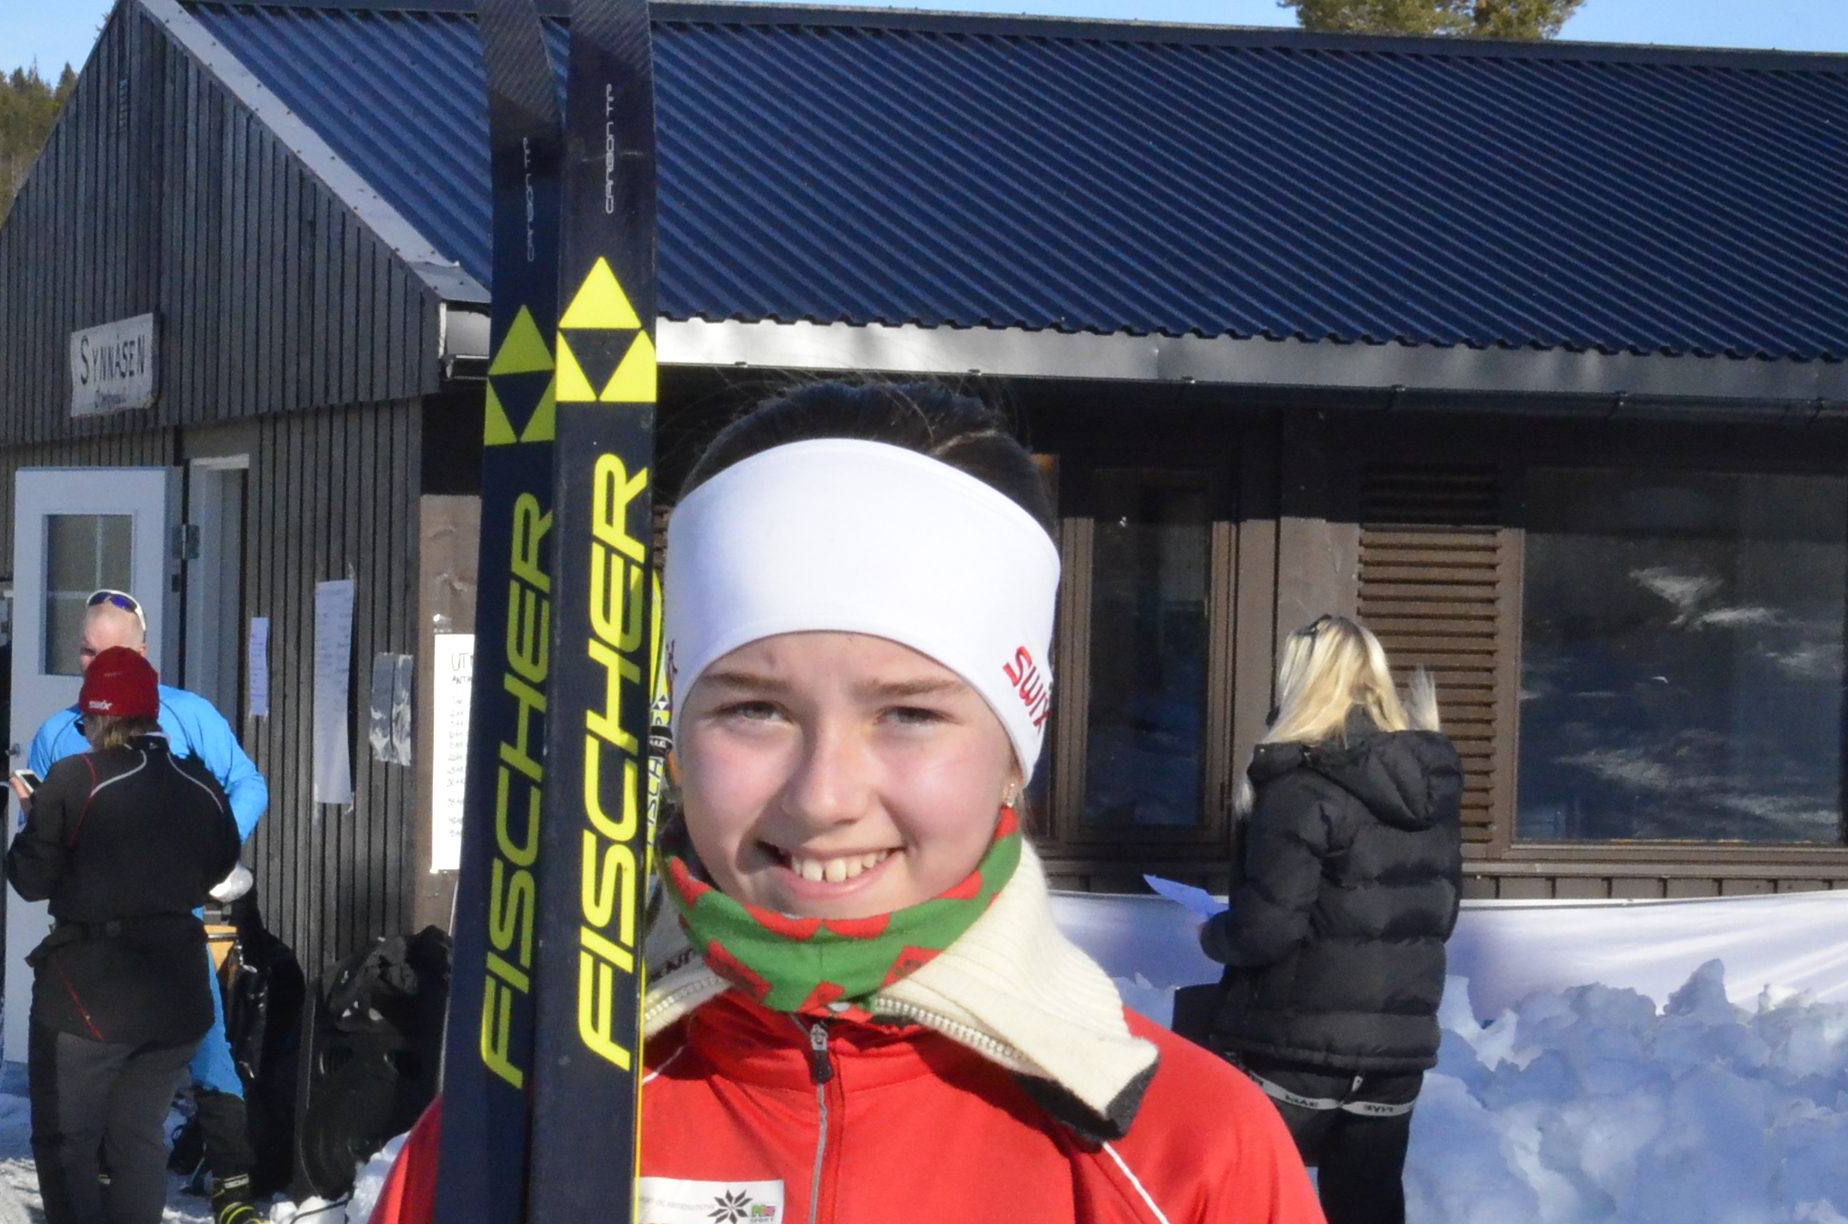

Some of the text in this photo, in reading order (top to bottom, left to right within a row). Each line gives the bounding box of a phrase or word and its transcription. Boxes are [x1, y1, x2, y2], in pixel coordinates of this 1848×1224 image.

[606, 119, 615, 215] CARBON
[481, 491, 552, 1090] FISCHER
[578, 453, 648, 1072] FISCHER
